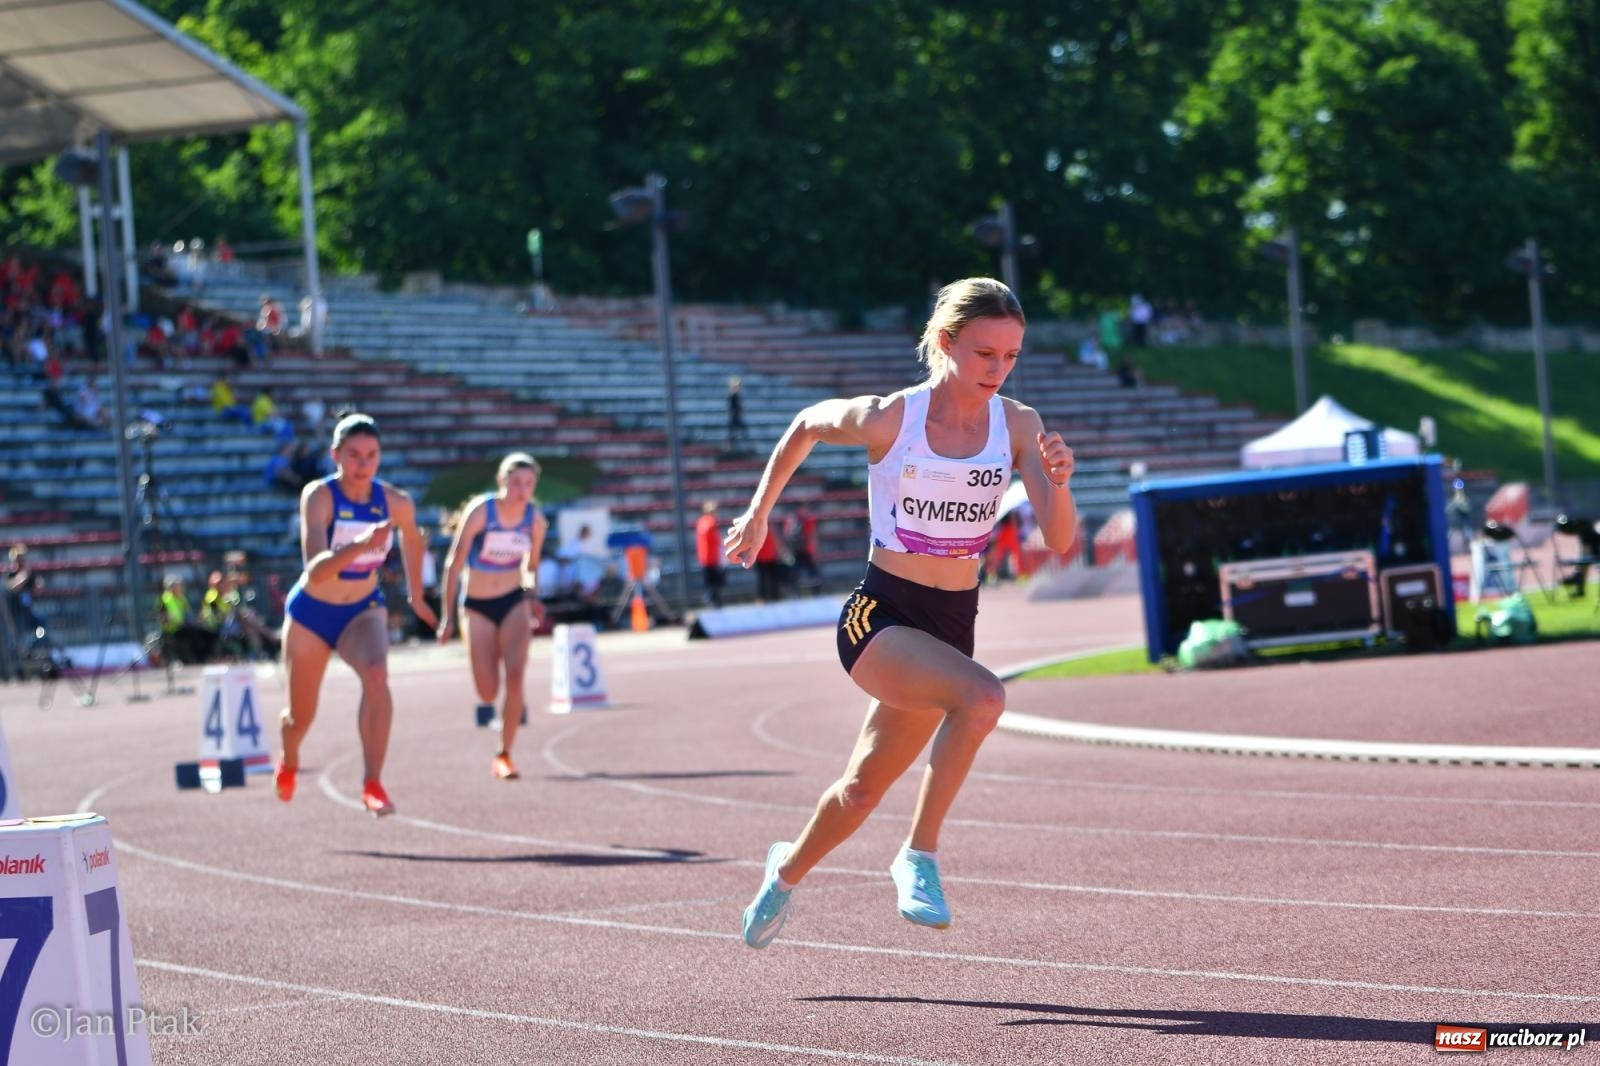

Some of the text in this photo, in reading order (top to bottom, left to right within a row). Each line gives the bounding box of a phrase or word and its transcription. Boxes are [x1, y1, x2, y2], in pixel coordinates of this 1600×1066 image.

[967, 467, 1003, 487] 305
[902, 495, 998, 523] GYMERSKÁ
[573, 641, 596, 688] 3
[205, 689, 224, 750] 4
[238, 686, 260, 748] 4
